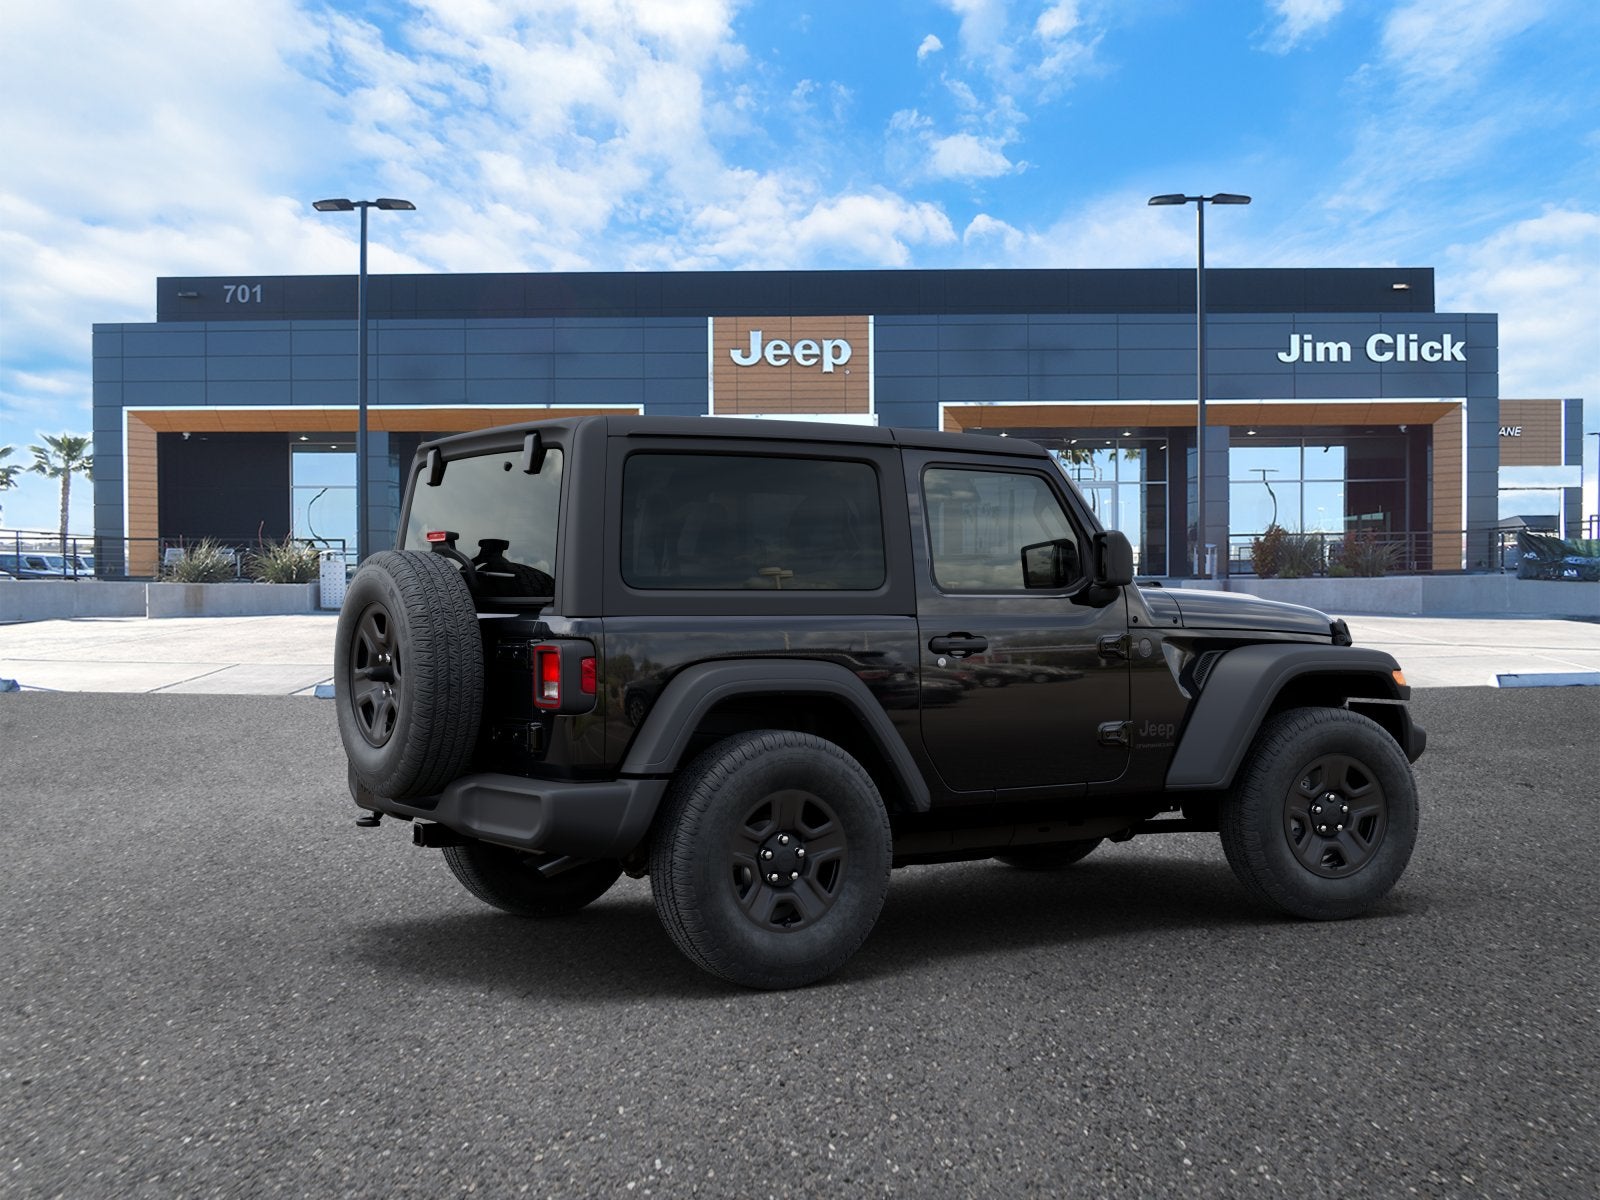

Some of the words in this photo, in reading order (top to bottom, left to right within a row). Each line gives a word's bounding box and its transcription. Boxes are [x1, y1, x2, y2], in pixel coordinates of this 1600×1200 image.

[223, 284, 262, 303] 701
[730, 330, 852, 374] Jeep
[1277, 333, 1351, 362] Jim
[1365, 333, 1467, 362] Click
[1139, 719, 1175, 739] Jeep
